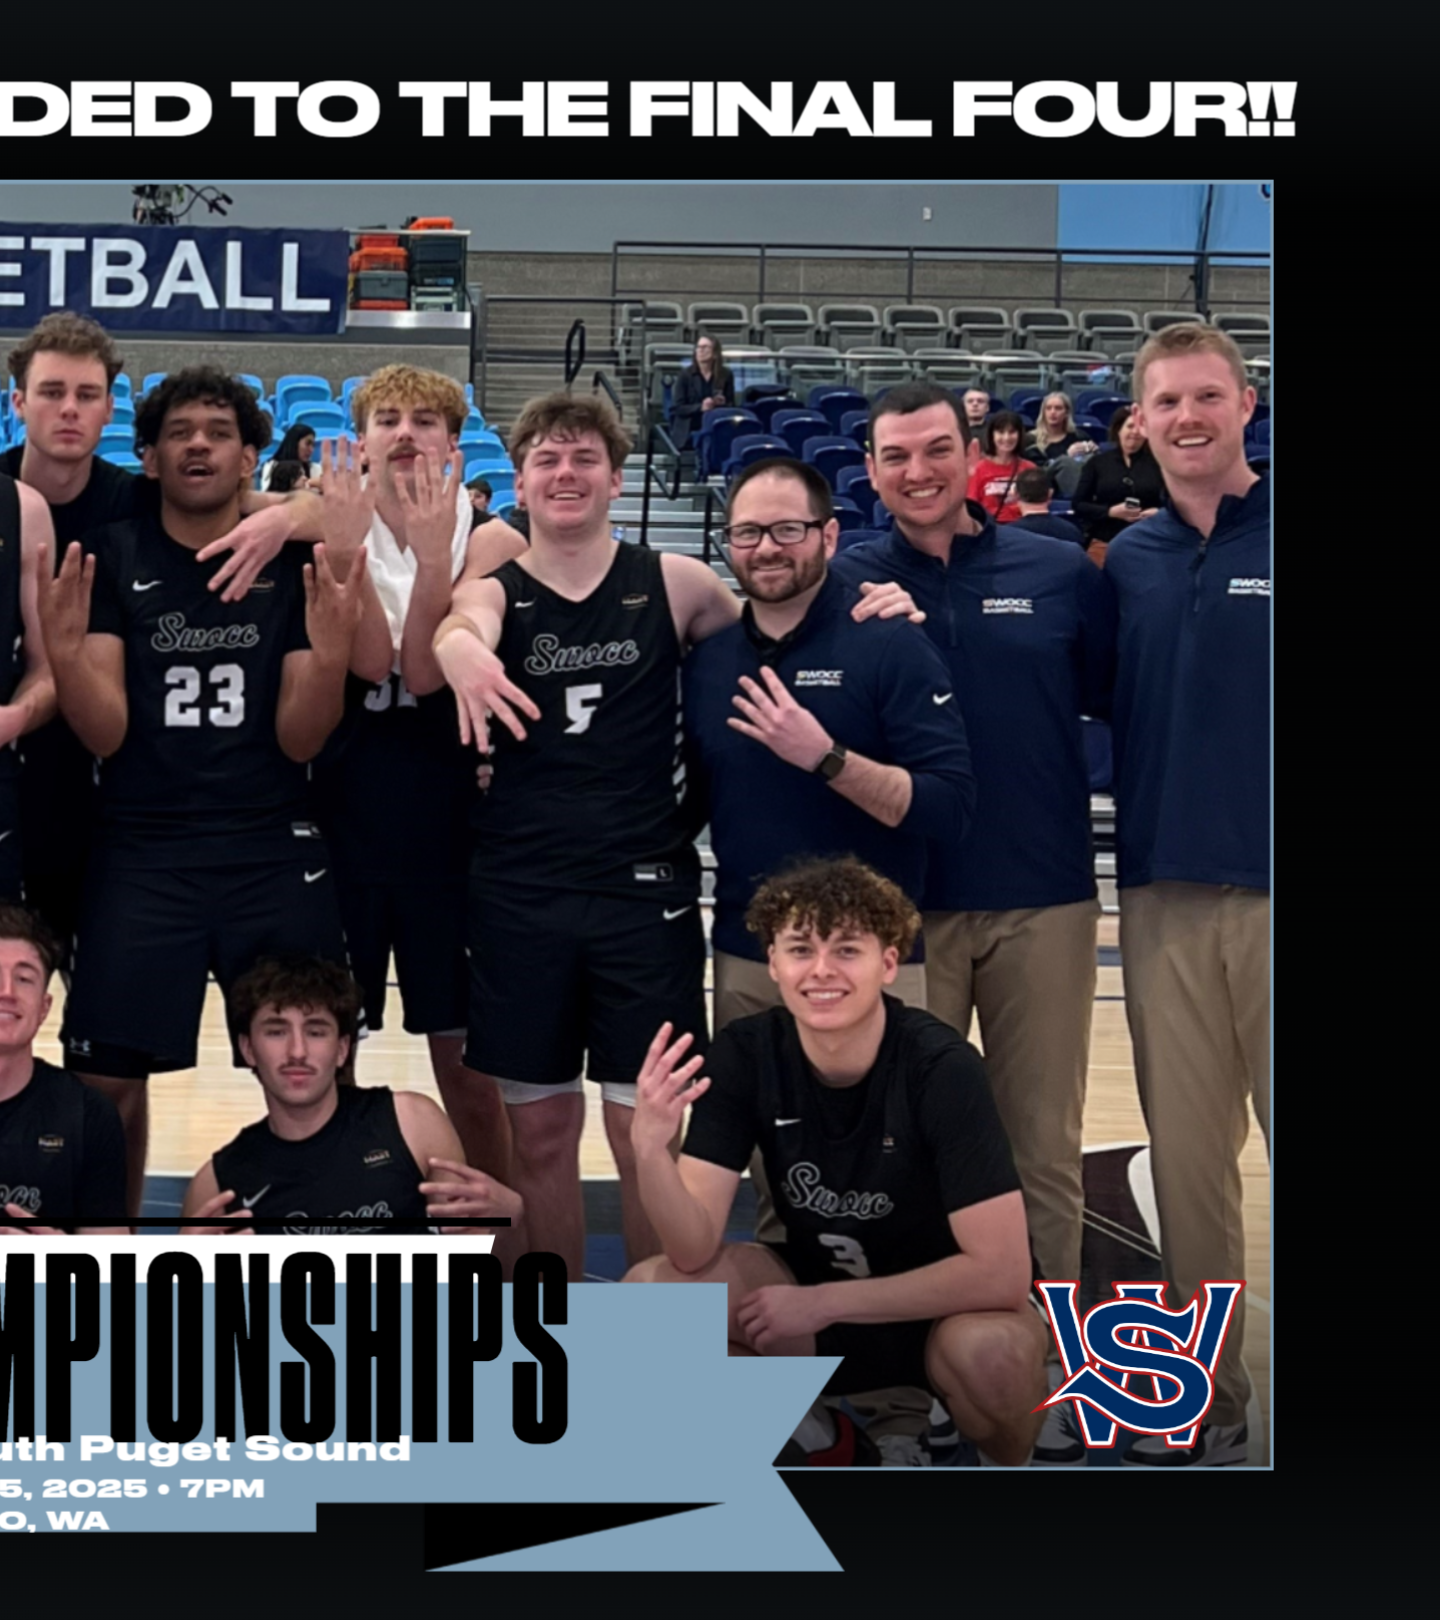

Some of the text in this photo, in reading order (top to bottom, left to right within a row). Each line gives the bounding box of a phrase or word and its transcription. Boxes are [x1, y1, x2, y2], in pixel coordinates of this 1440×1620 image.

[981, 598, 1033, 607] SWOCC
[1229, 577, 1270, 588] SWOC
[151, 611, 260, 652] Swocc
[524, 634, 640, 675] Swocc
[796, 669, 844, 679] SWOCC
[163, 662, 246, 728] 23
[563, 682, 604, 734] 5
[817, 1232, 872, 1279] 3
